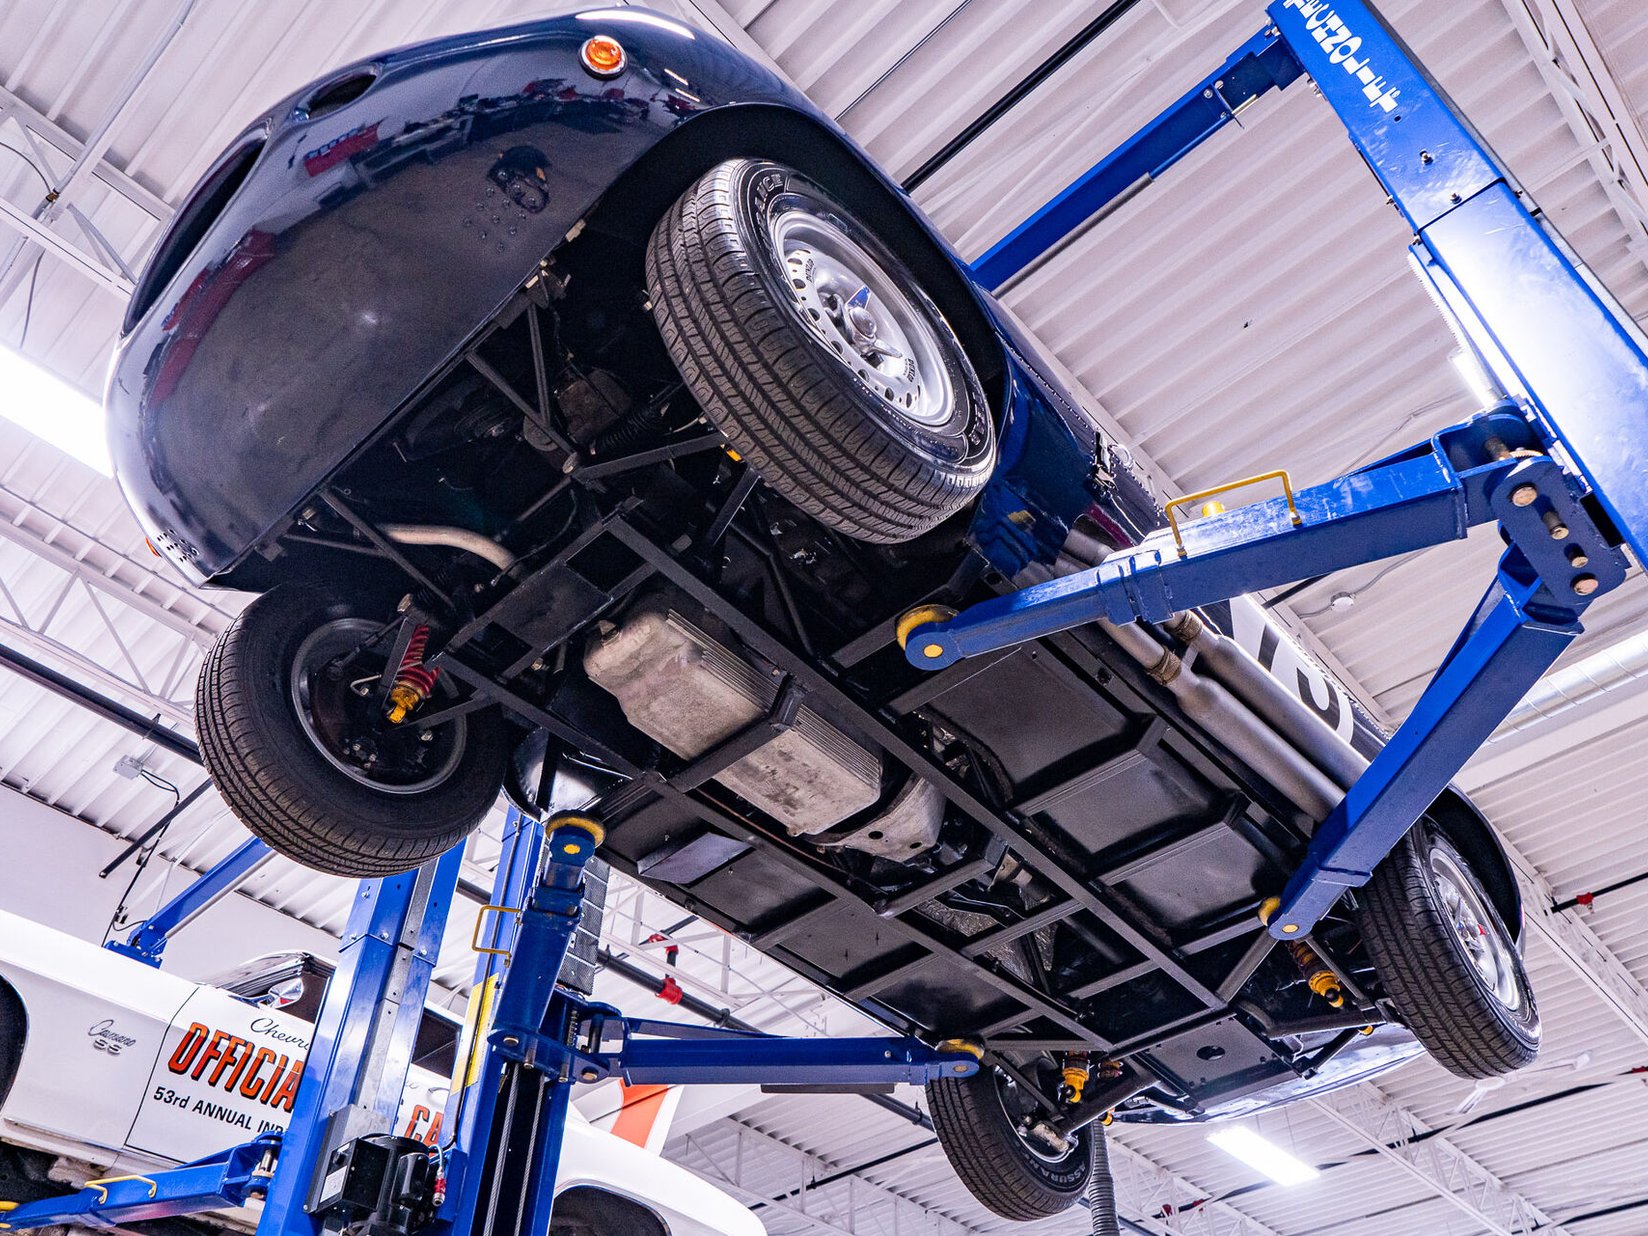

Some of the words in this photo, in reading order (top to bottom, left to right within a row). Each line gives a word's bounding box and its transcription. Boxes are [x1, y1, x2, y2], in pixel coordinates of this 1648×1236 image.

[88, 1019, 137, 1047] Camaro
[93, 1039, 122, 1055] SS
[153, 1086, 191, 1109] 53rd
[192, 1100, 252, 1130] ANNUAL
